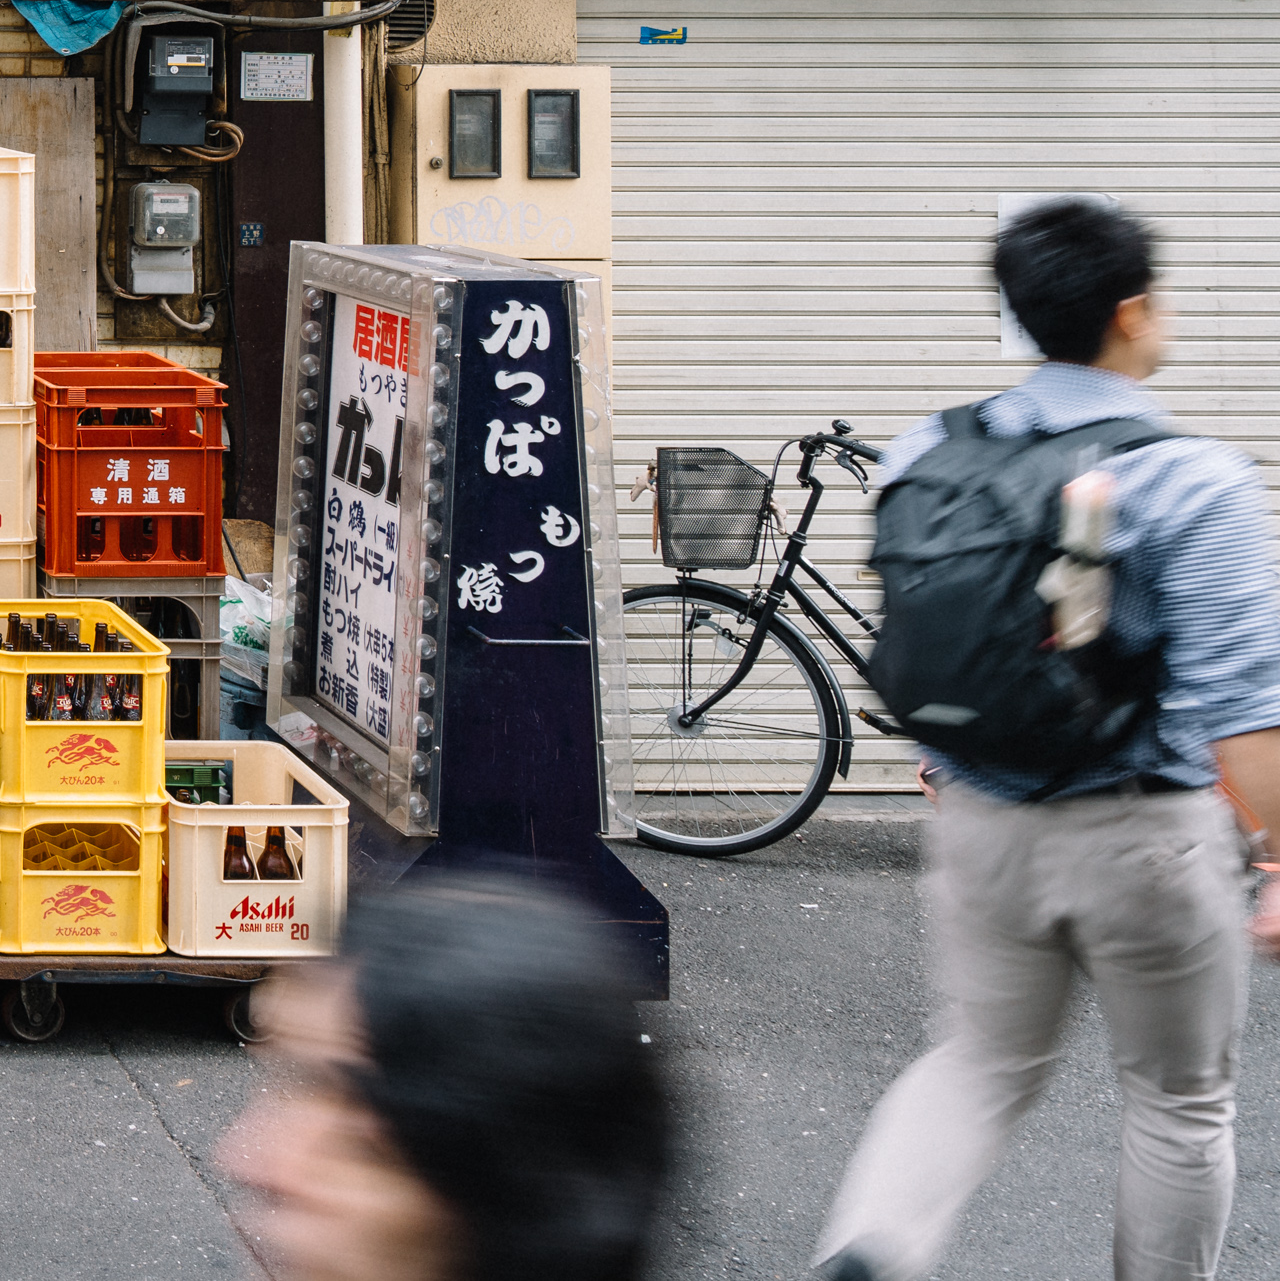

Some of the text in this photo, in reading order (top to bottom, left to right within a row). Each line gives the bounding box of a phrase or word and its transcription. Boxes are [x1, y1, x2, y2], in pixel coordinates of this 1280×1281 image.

[243, 230, 261, 238] 上野
[353, 304, 421, 377] 居酒屋
[478, 299, 562, 478] かっぱ
[106, 458, 170, 482] 清酒
[90, 486, 186, 505] 専用通箱
[327, 487, 366, 539] 白鶴
[325, 525, 395, 593] スーパードライ
[323, 561, 362, 609] 酎ハイ
[322, 598, 361, 647] もつ焼
[319, 665, 359, 719] お新香
[59, 775, 106, 786] 大びん20本
[230, 895, 295, 921] Asahi
[55, 926, 101, 937] 大びん20本
[215, 922, 309, 941] 大 ASAHI BEER 20
